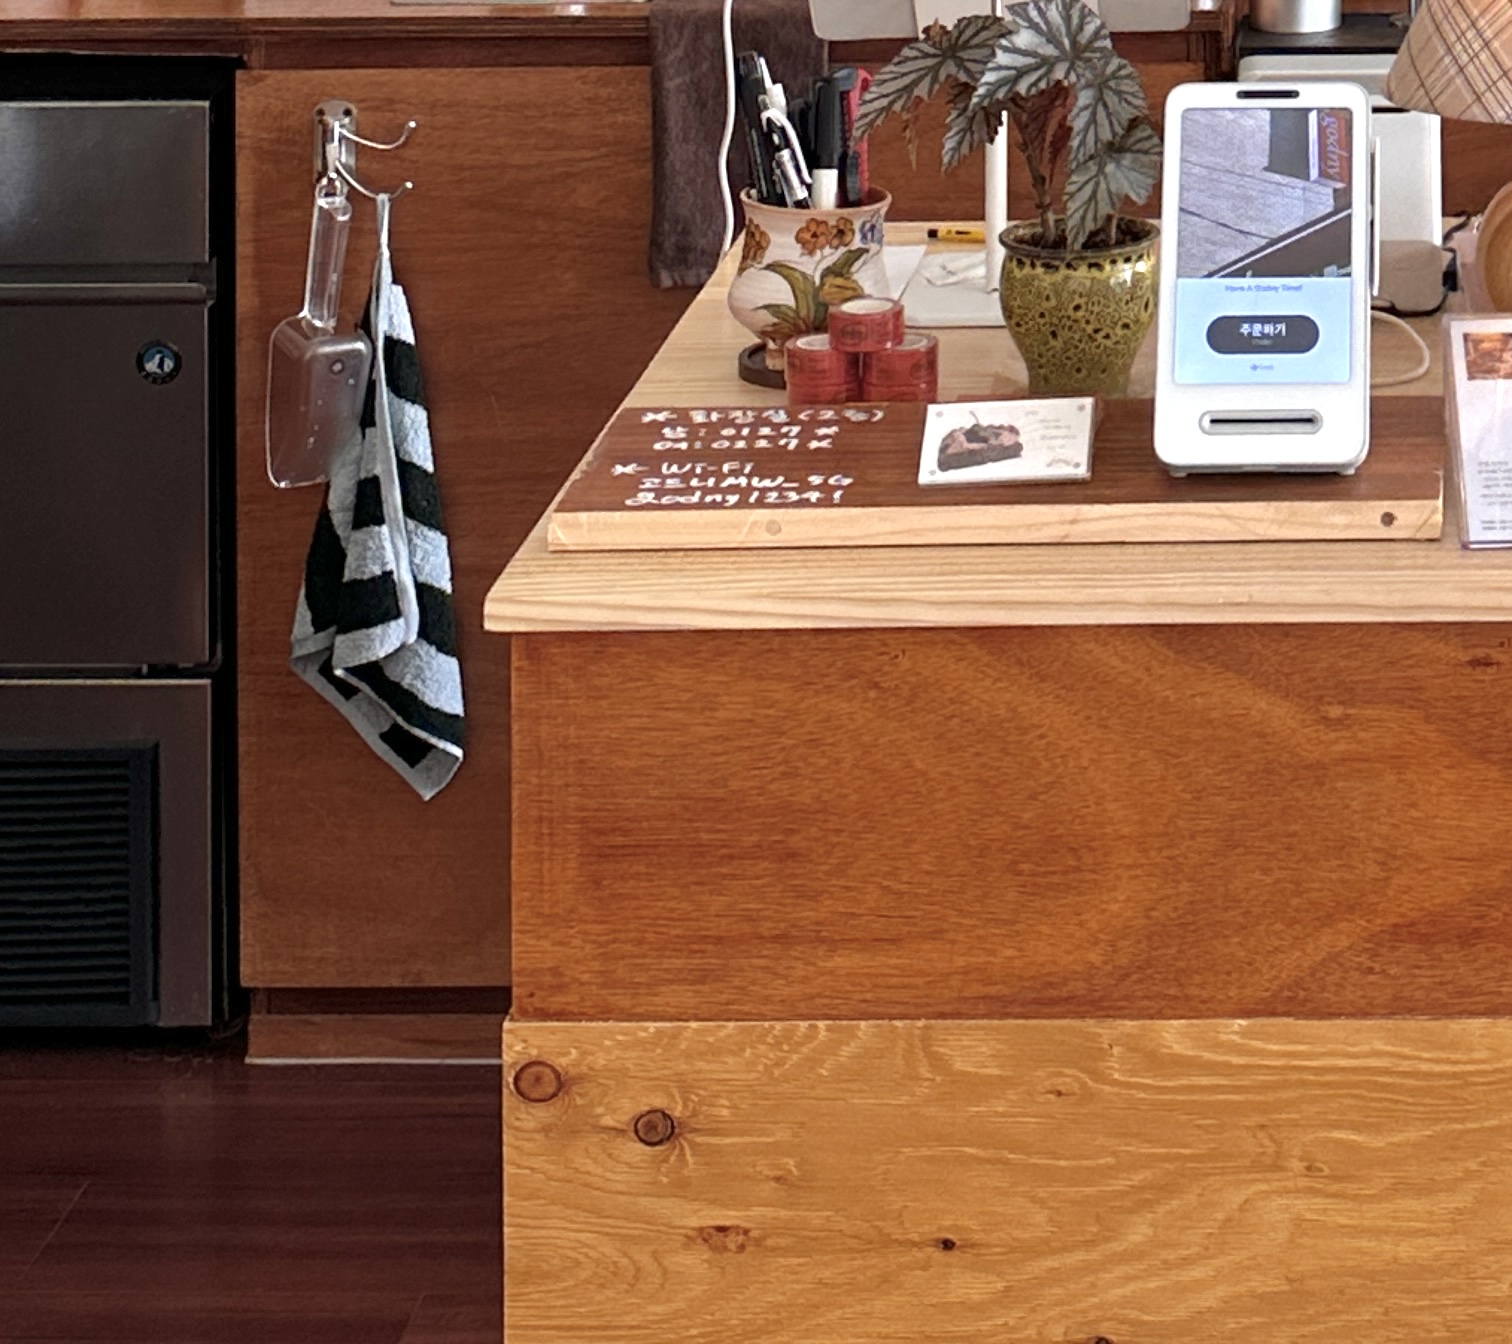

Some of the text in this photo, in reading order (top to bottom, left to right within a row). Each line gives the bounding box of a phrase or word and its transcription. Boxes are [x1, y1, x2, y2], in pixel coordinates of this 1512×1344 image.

[1320, 112, 1349, 180] godny
[1239, 322, 1287, 338] 주문하기
[689, 409, 791, 424] 화장실
